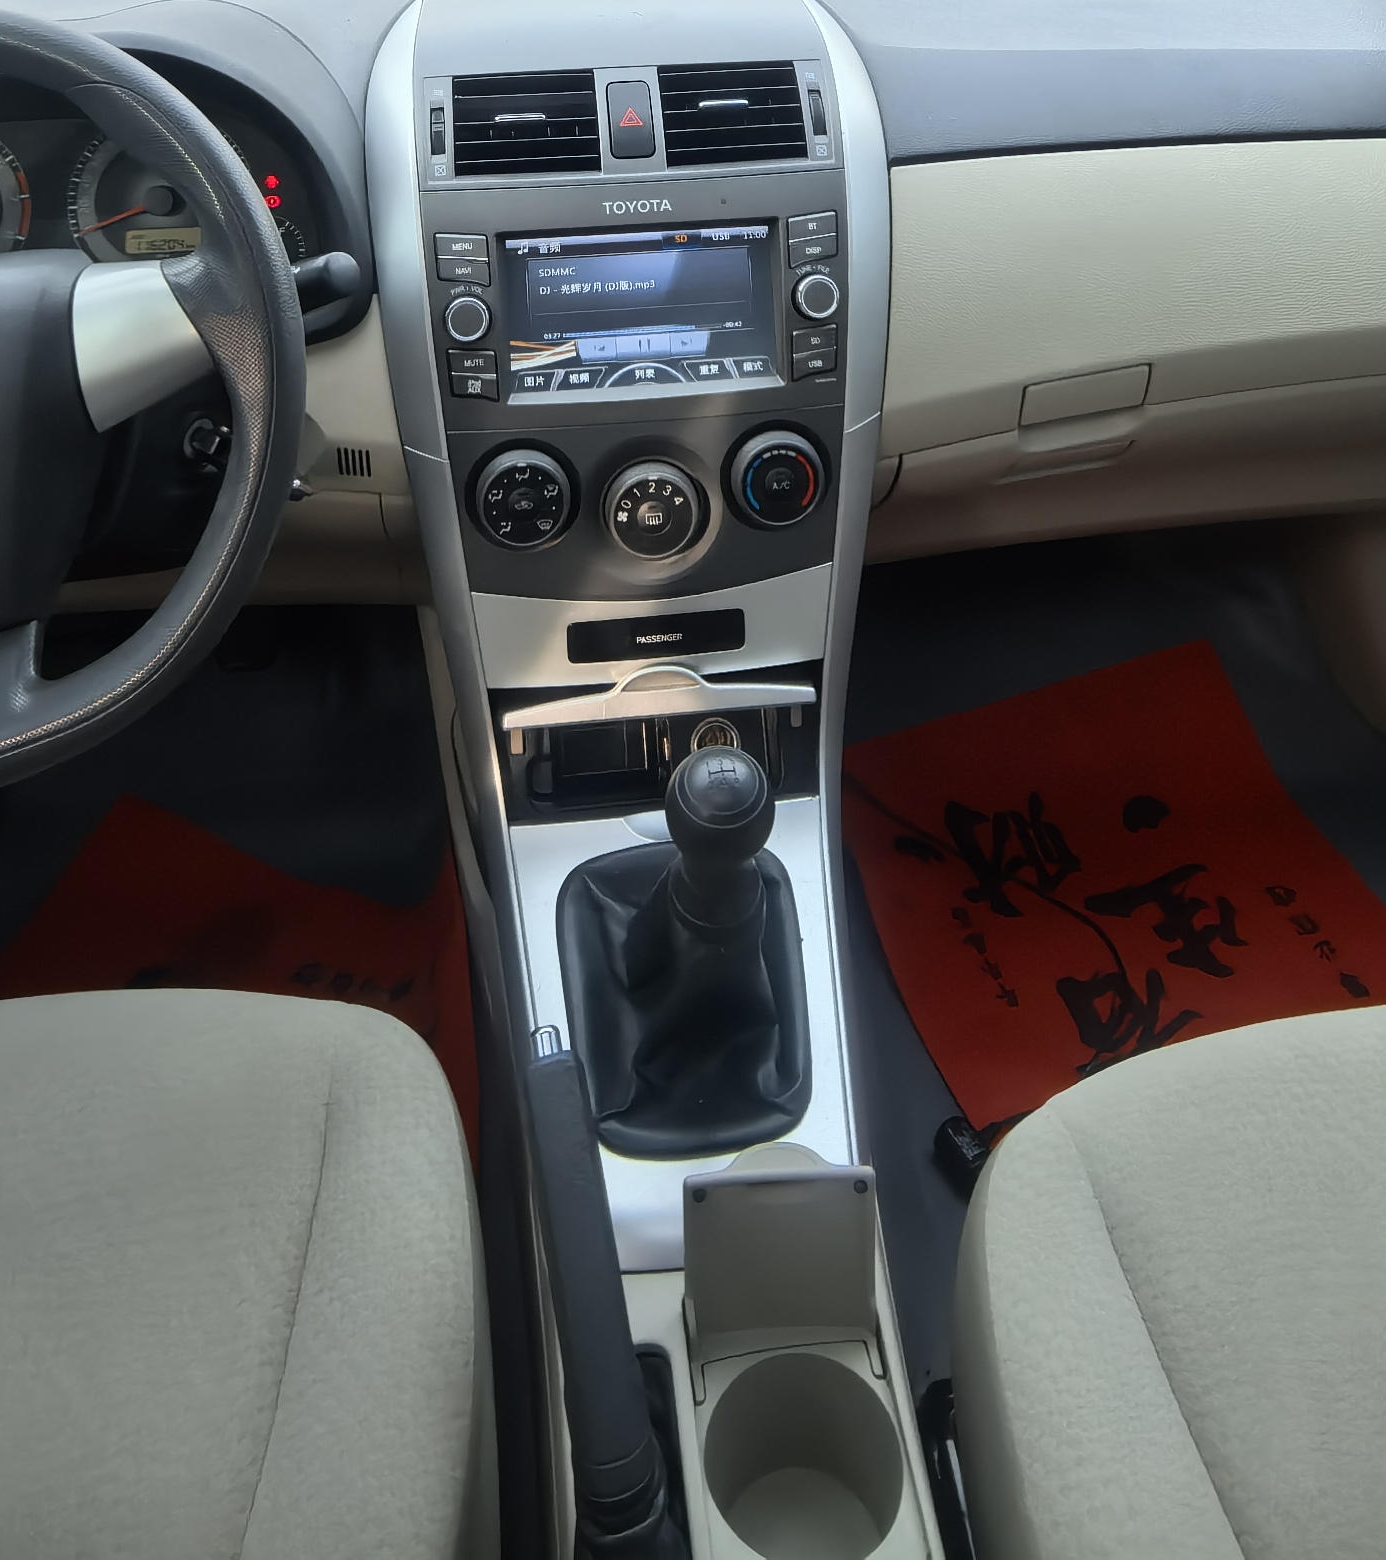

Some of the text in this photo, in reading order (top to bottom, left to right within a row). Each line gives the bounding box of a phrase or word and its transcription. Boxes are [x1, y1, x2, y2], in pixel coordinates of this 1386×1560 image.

[601, 198, 673, 216] TOYOTA
[675, 234, 688, 243] SD
[451, 241, 473, 251] MENU
[538, 242, 561, 254] 音频
[455, 267, 472, 275] NAVI
[538, 267, 576, 277] SDMMC
[463, 358, 485, 367] MUTE
[524, 361, 764, 387] 图片 视频 列表 重复 模式
[771, 479, 790, 491] A/C
[648, 482, 656, 493] 2
[662, 484, 672, 496] 3
[674, 496, 684, 506] 4
[635, 631, 683, 645] PASSENGER
